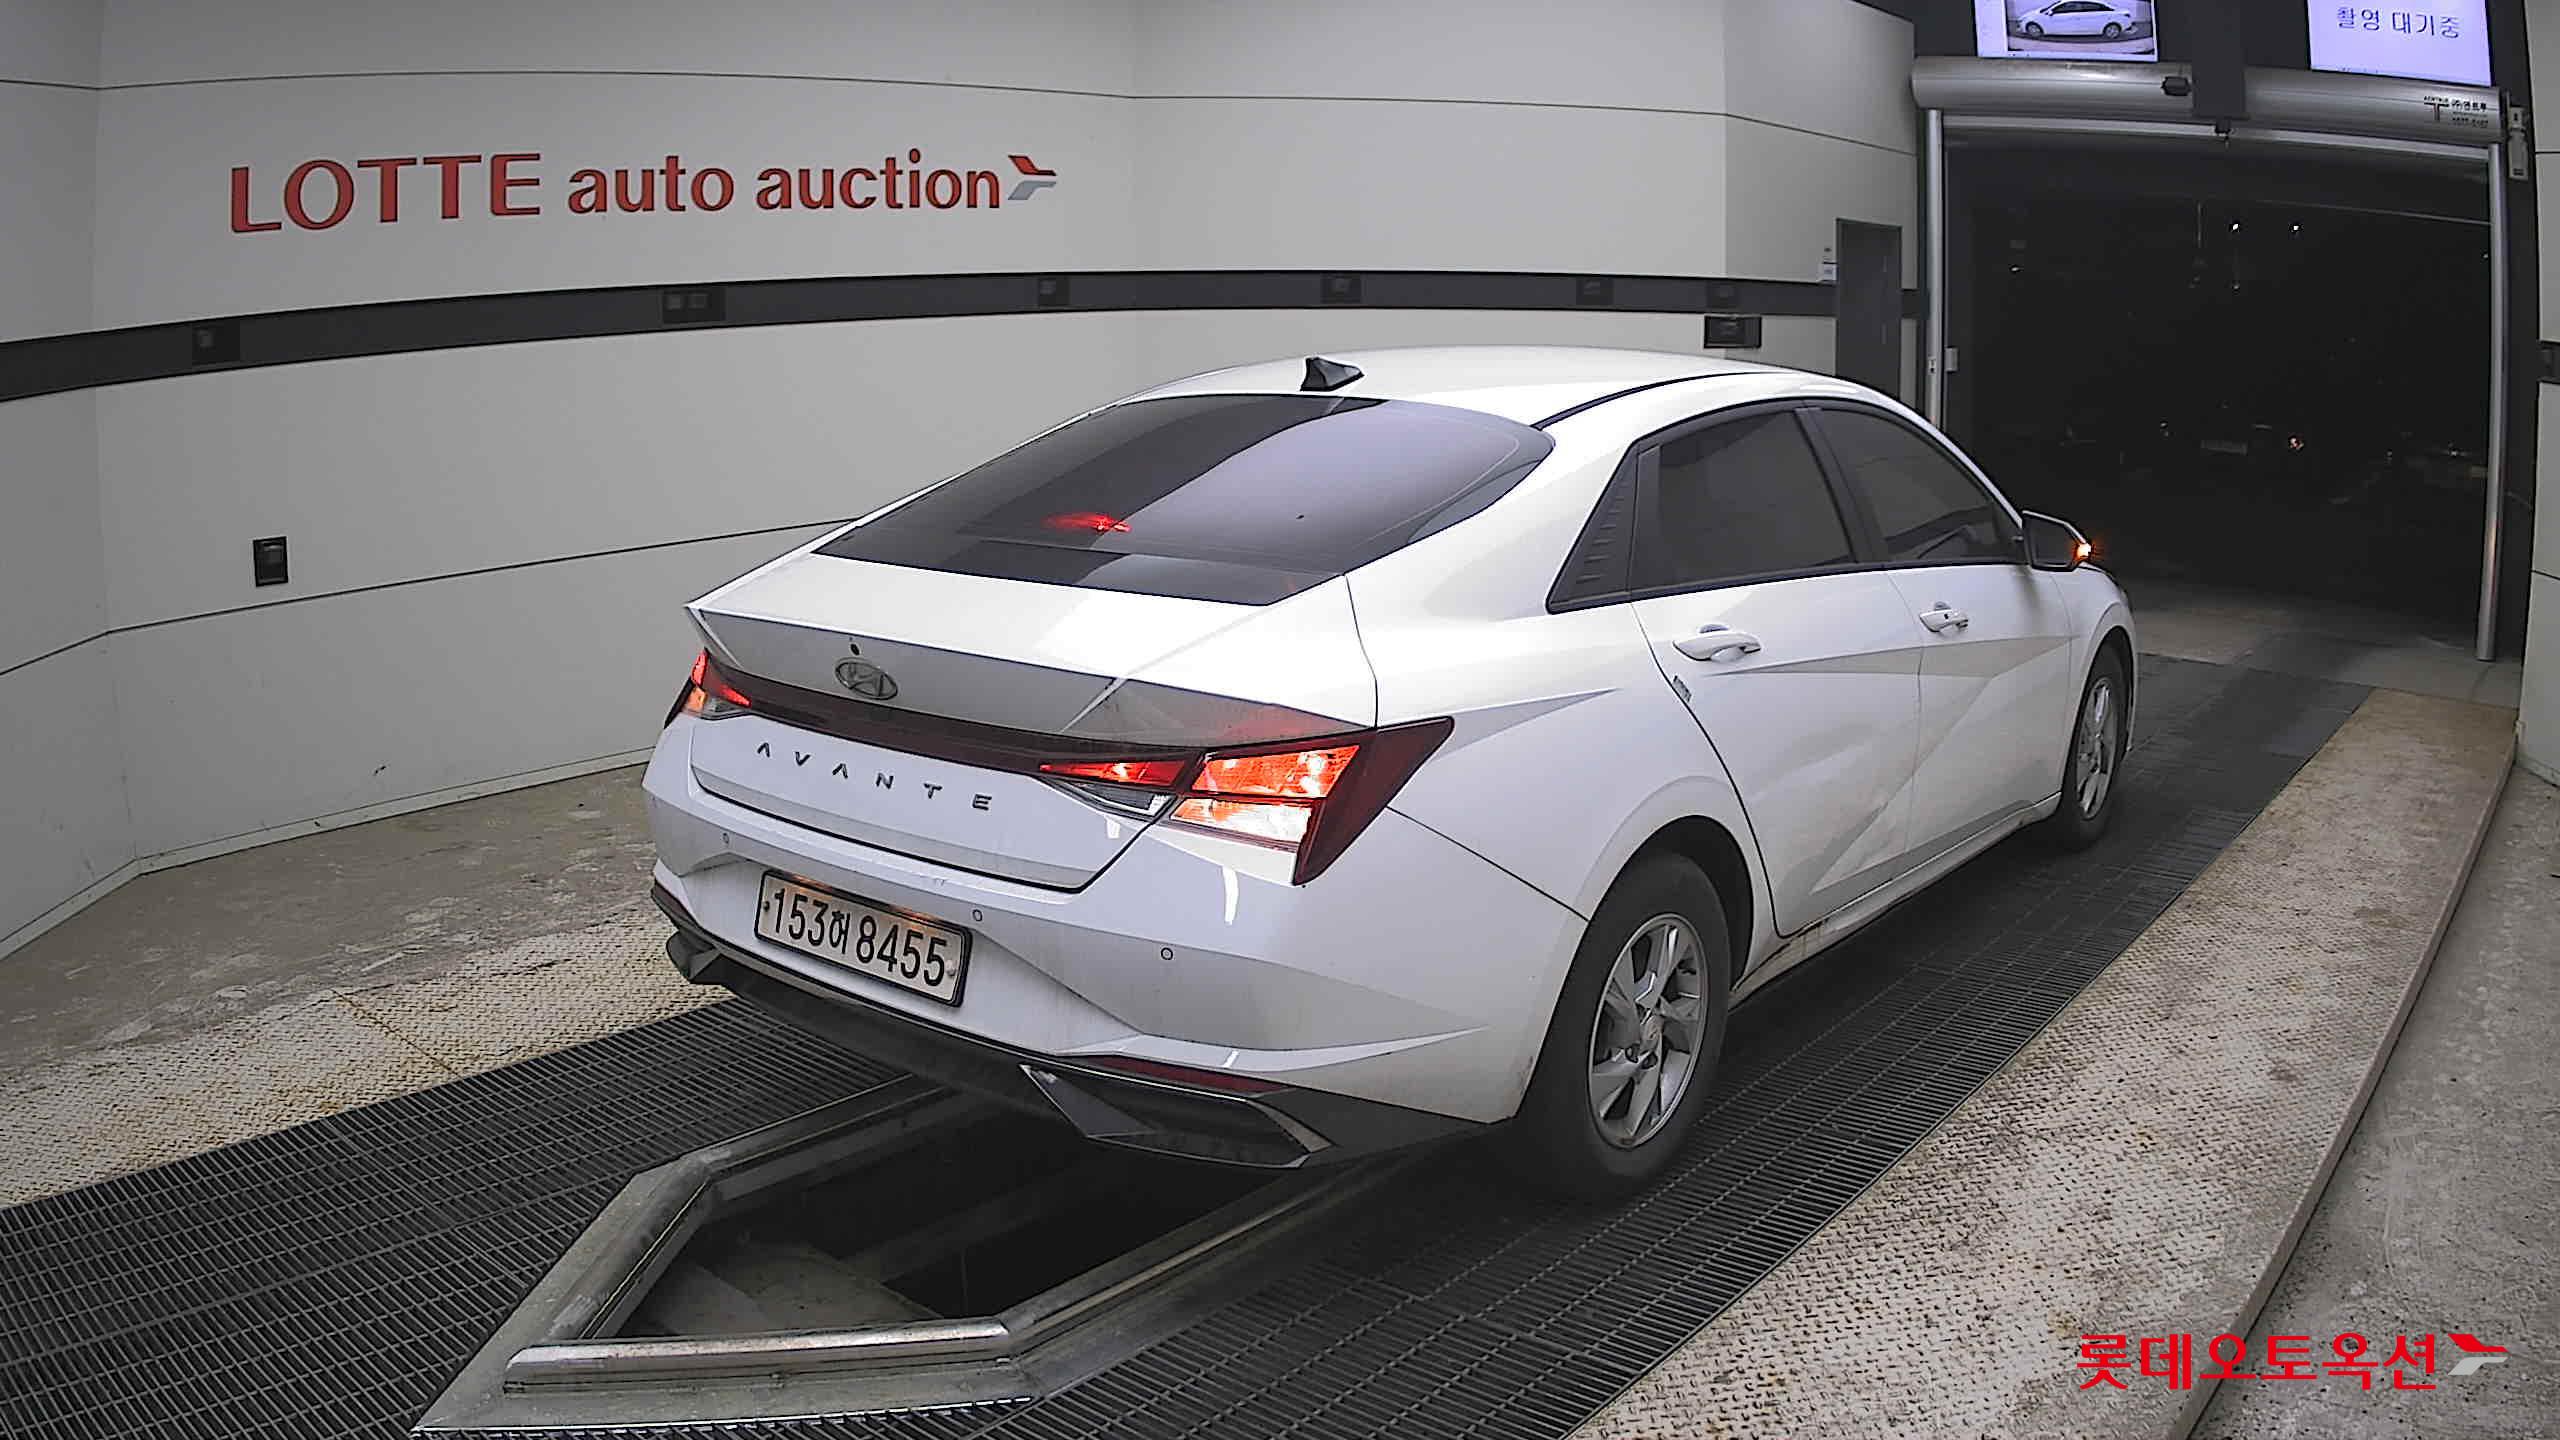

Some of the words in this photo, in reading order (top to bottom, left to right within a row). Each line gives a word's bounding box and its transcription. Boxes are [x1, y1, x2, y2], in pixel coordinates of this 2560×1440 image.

[2337, 7, 2380, 31] 촬영
[231, 153, 541, 232] LOTTE
[567, 154, 735, 214] auto
[756, 148, 1001, 210] auction
[757, 742, 993, 811] AVANTE
